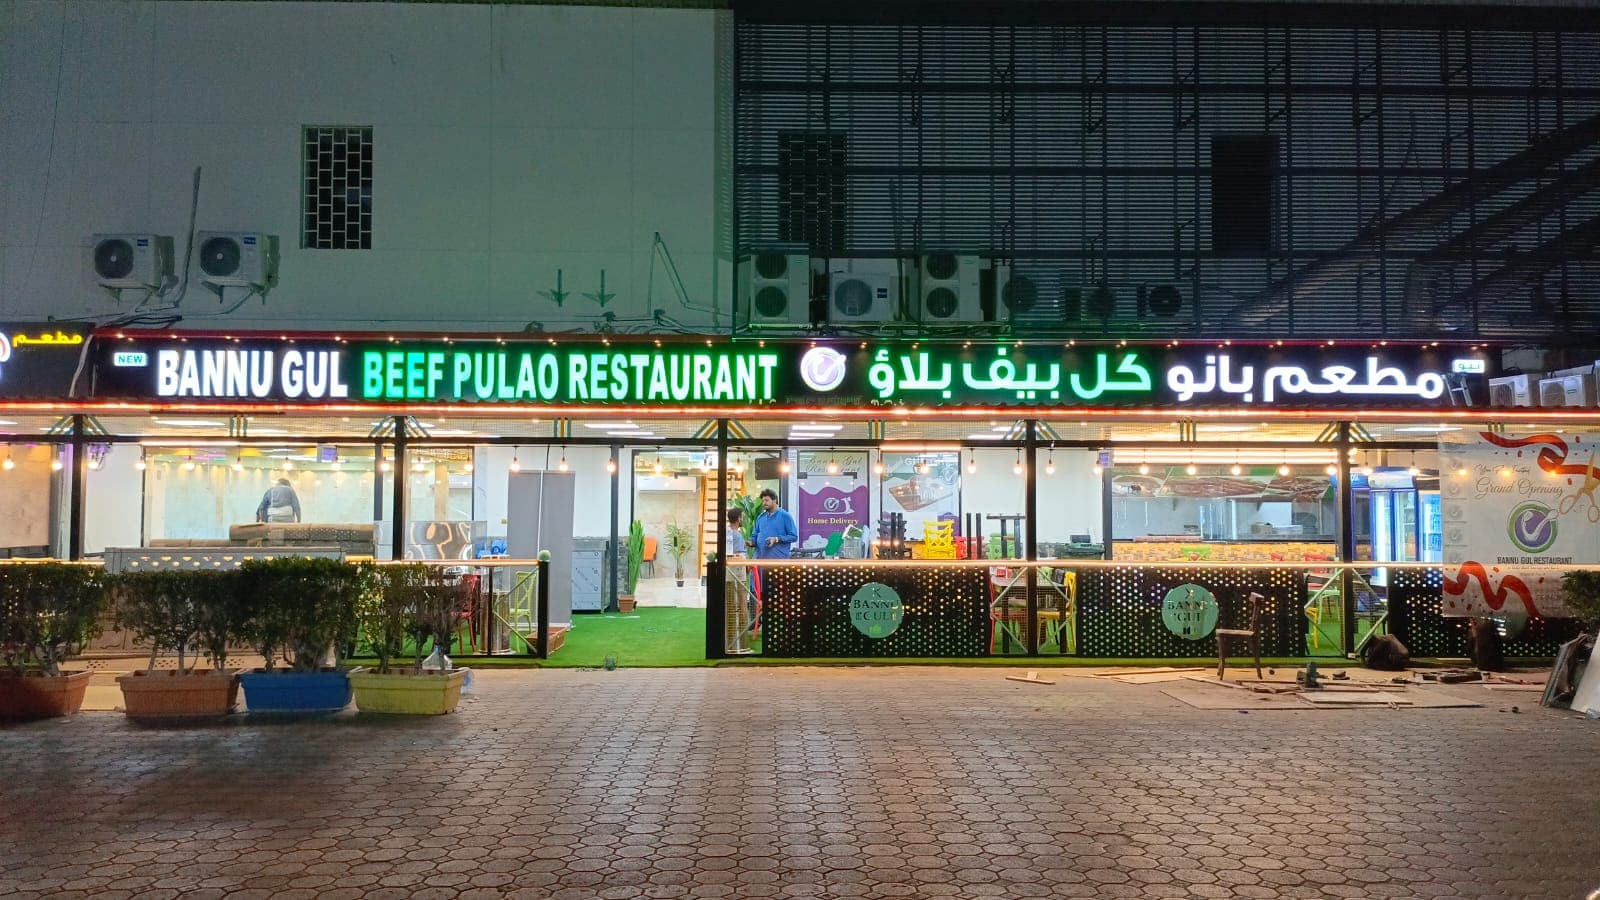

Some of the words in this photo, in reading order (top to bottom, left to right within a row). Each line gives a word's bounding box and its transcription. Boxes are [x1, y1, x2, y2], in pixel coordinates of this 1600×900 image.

[12, 331, 83, 348] مطعم
[118, 355, 143, 363] NEW
[157, 349, 274, 397] BANNU
[281, 350, 348, 398] GUL
[362, 351, 445, 399] BEEF
[453, 352, 560, 399] PULAO
[568, 353, 778, 401] RESTAURANT
[868, 348, 952, 399] بلاؤ
[962, 346, 1060, 400] بيف
[1070, 353, 1152, 400] كل
[1166, 355, 1254, 403] بانو
[1263, 356, 1446, 403] مطعم
[1474, 476, 1516, 499] Grand
[1518, 479, 1564, 498] Opening
[807, 517, 829, 525] Home
[830, 517, 859, 526] Delivery
[1533, 557, 1573, 565] RESTAURANT
